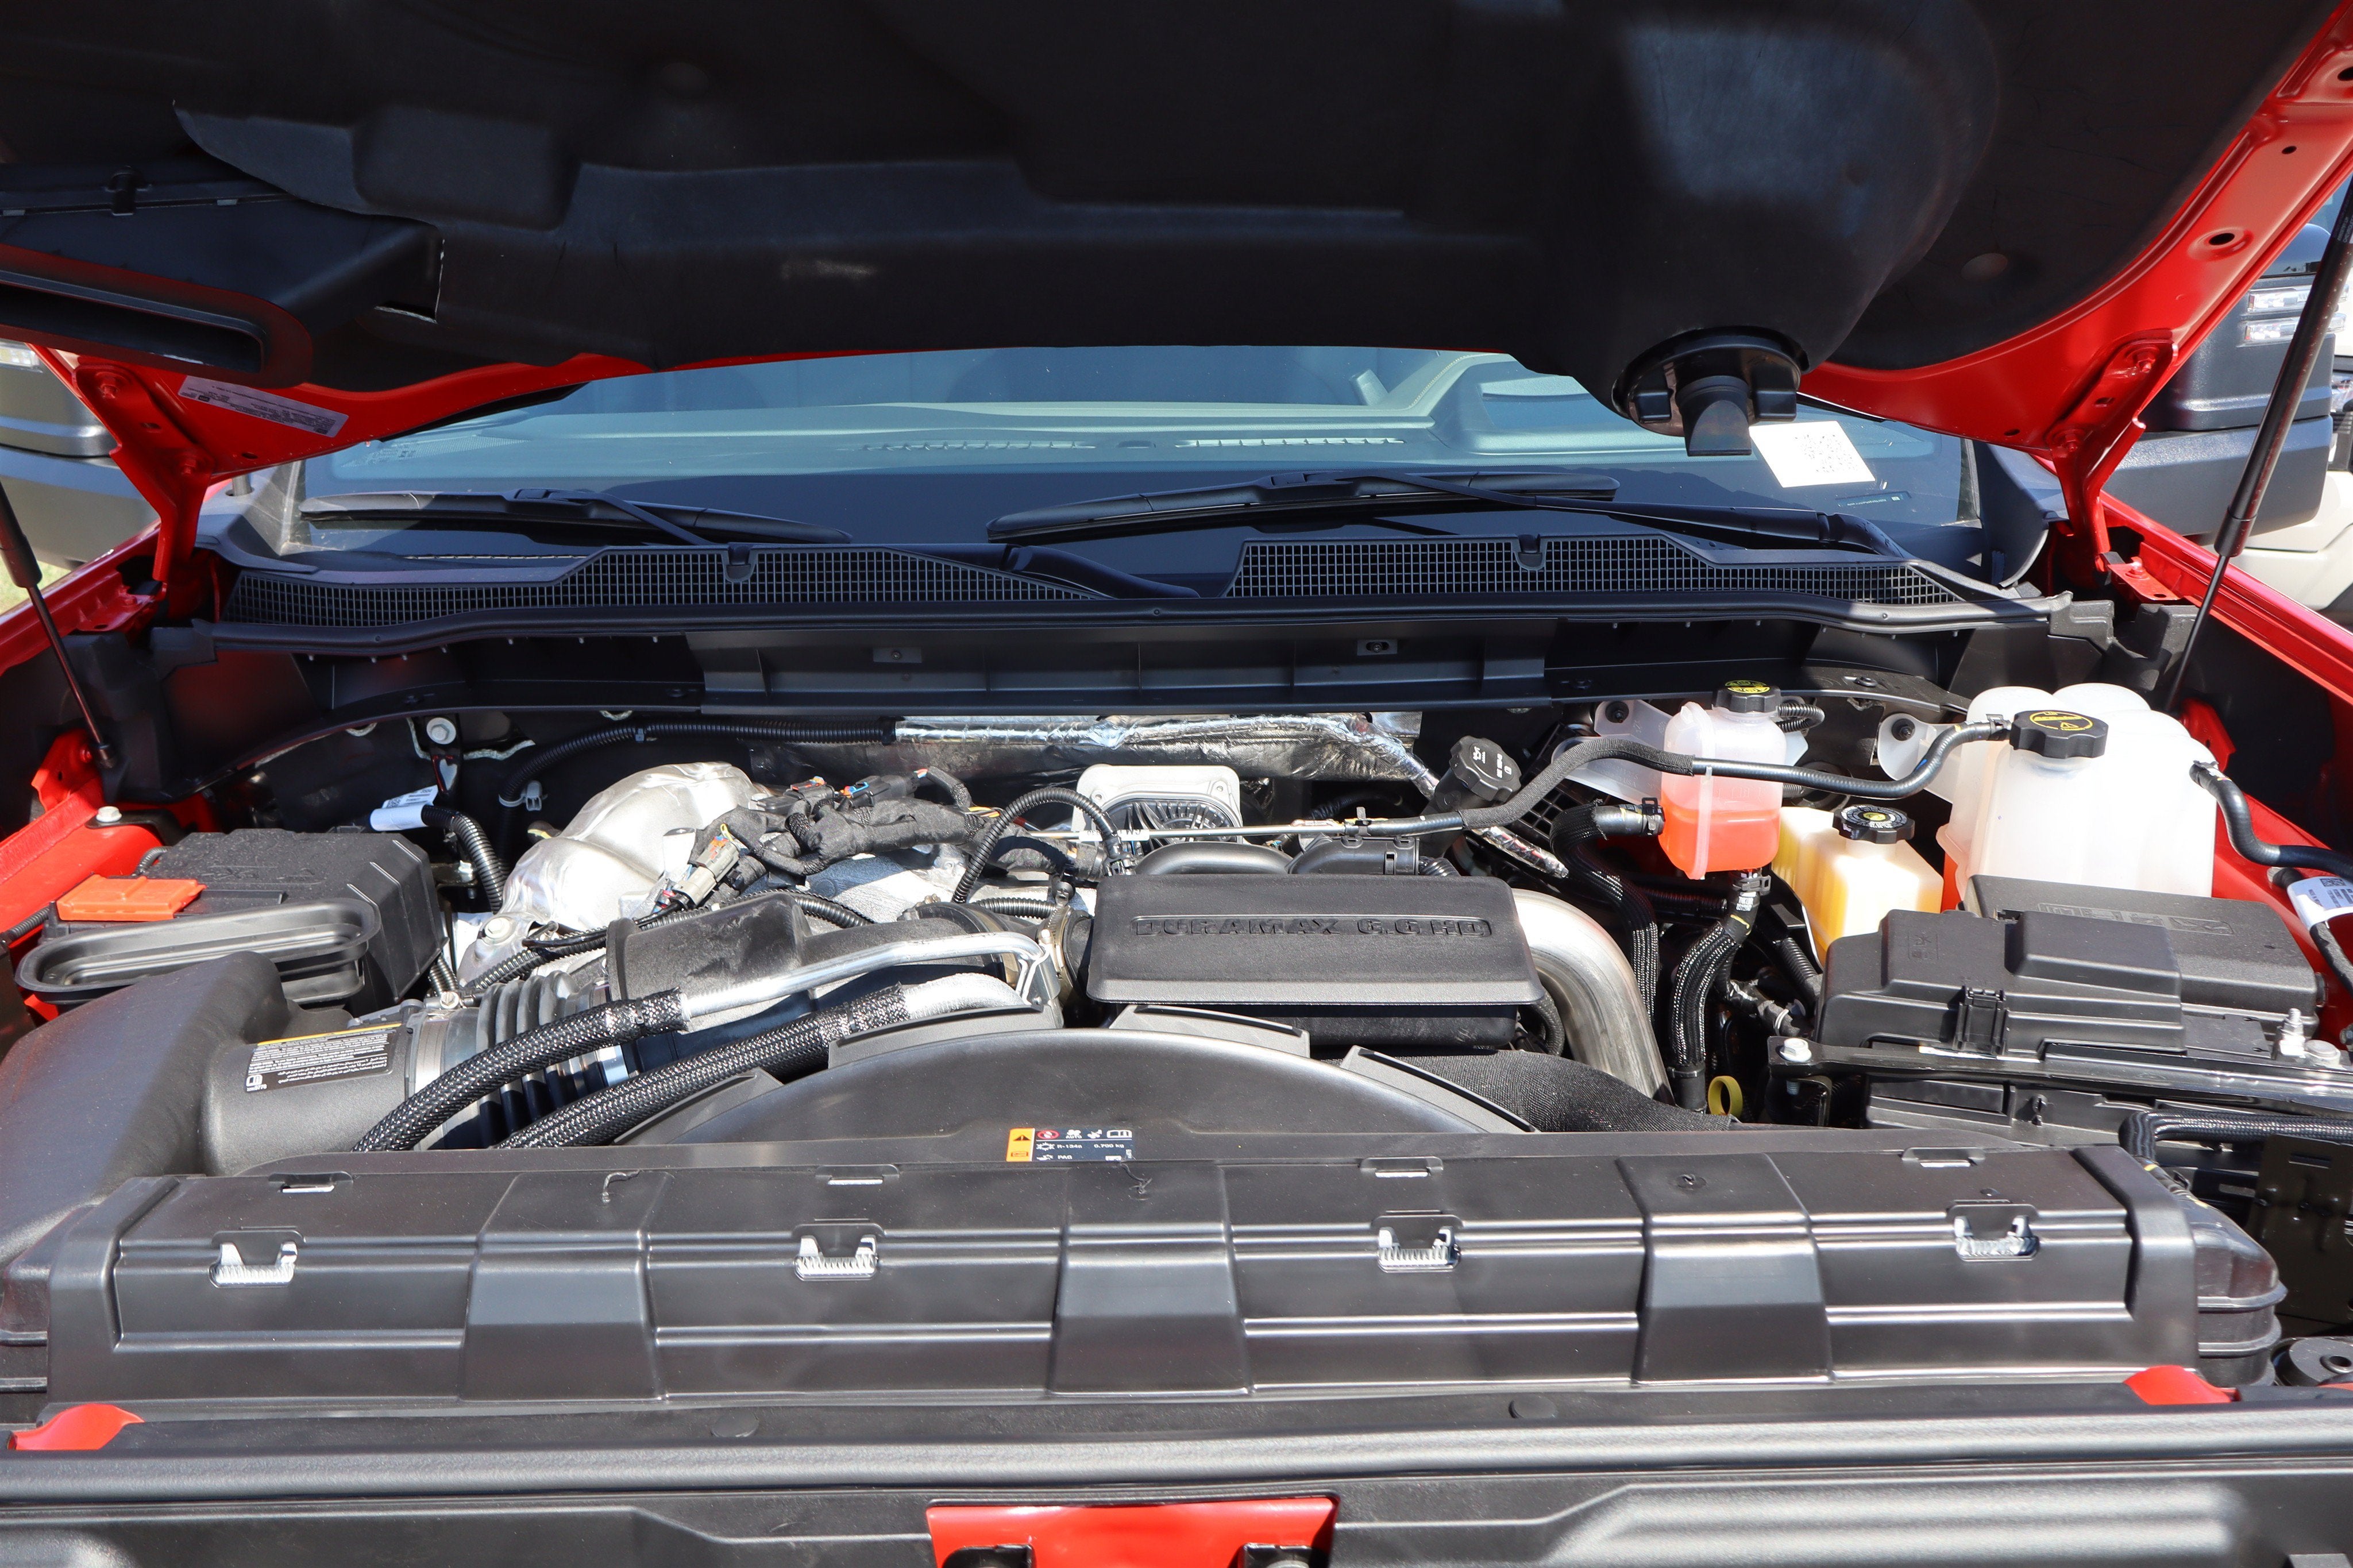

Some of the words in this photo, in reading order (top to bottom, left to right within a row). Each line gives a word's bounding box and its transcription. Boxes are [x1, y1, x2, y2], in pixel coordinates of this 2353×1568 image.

[1136, 918, 1341, 937] DURAMAX
[1357, 918, 1423, 937] 6.6
[1430, 918, 1492, 937] HD
